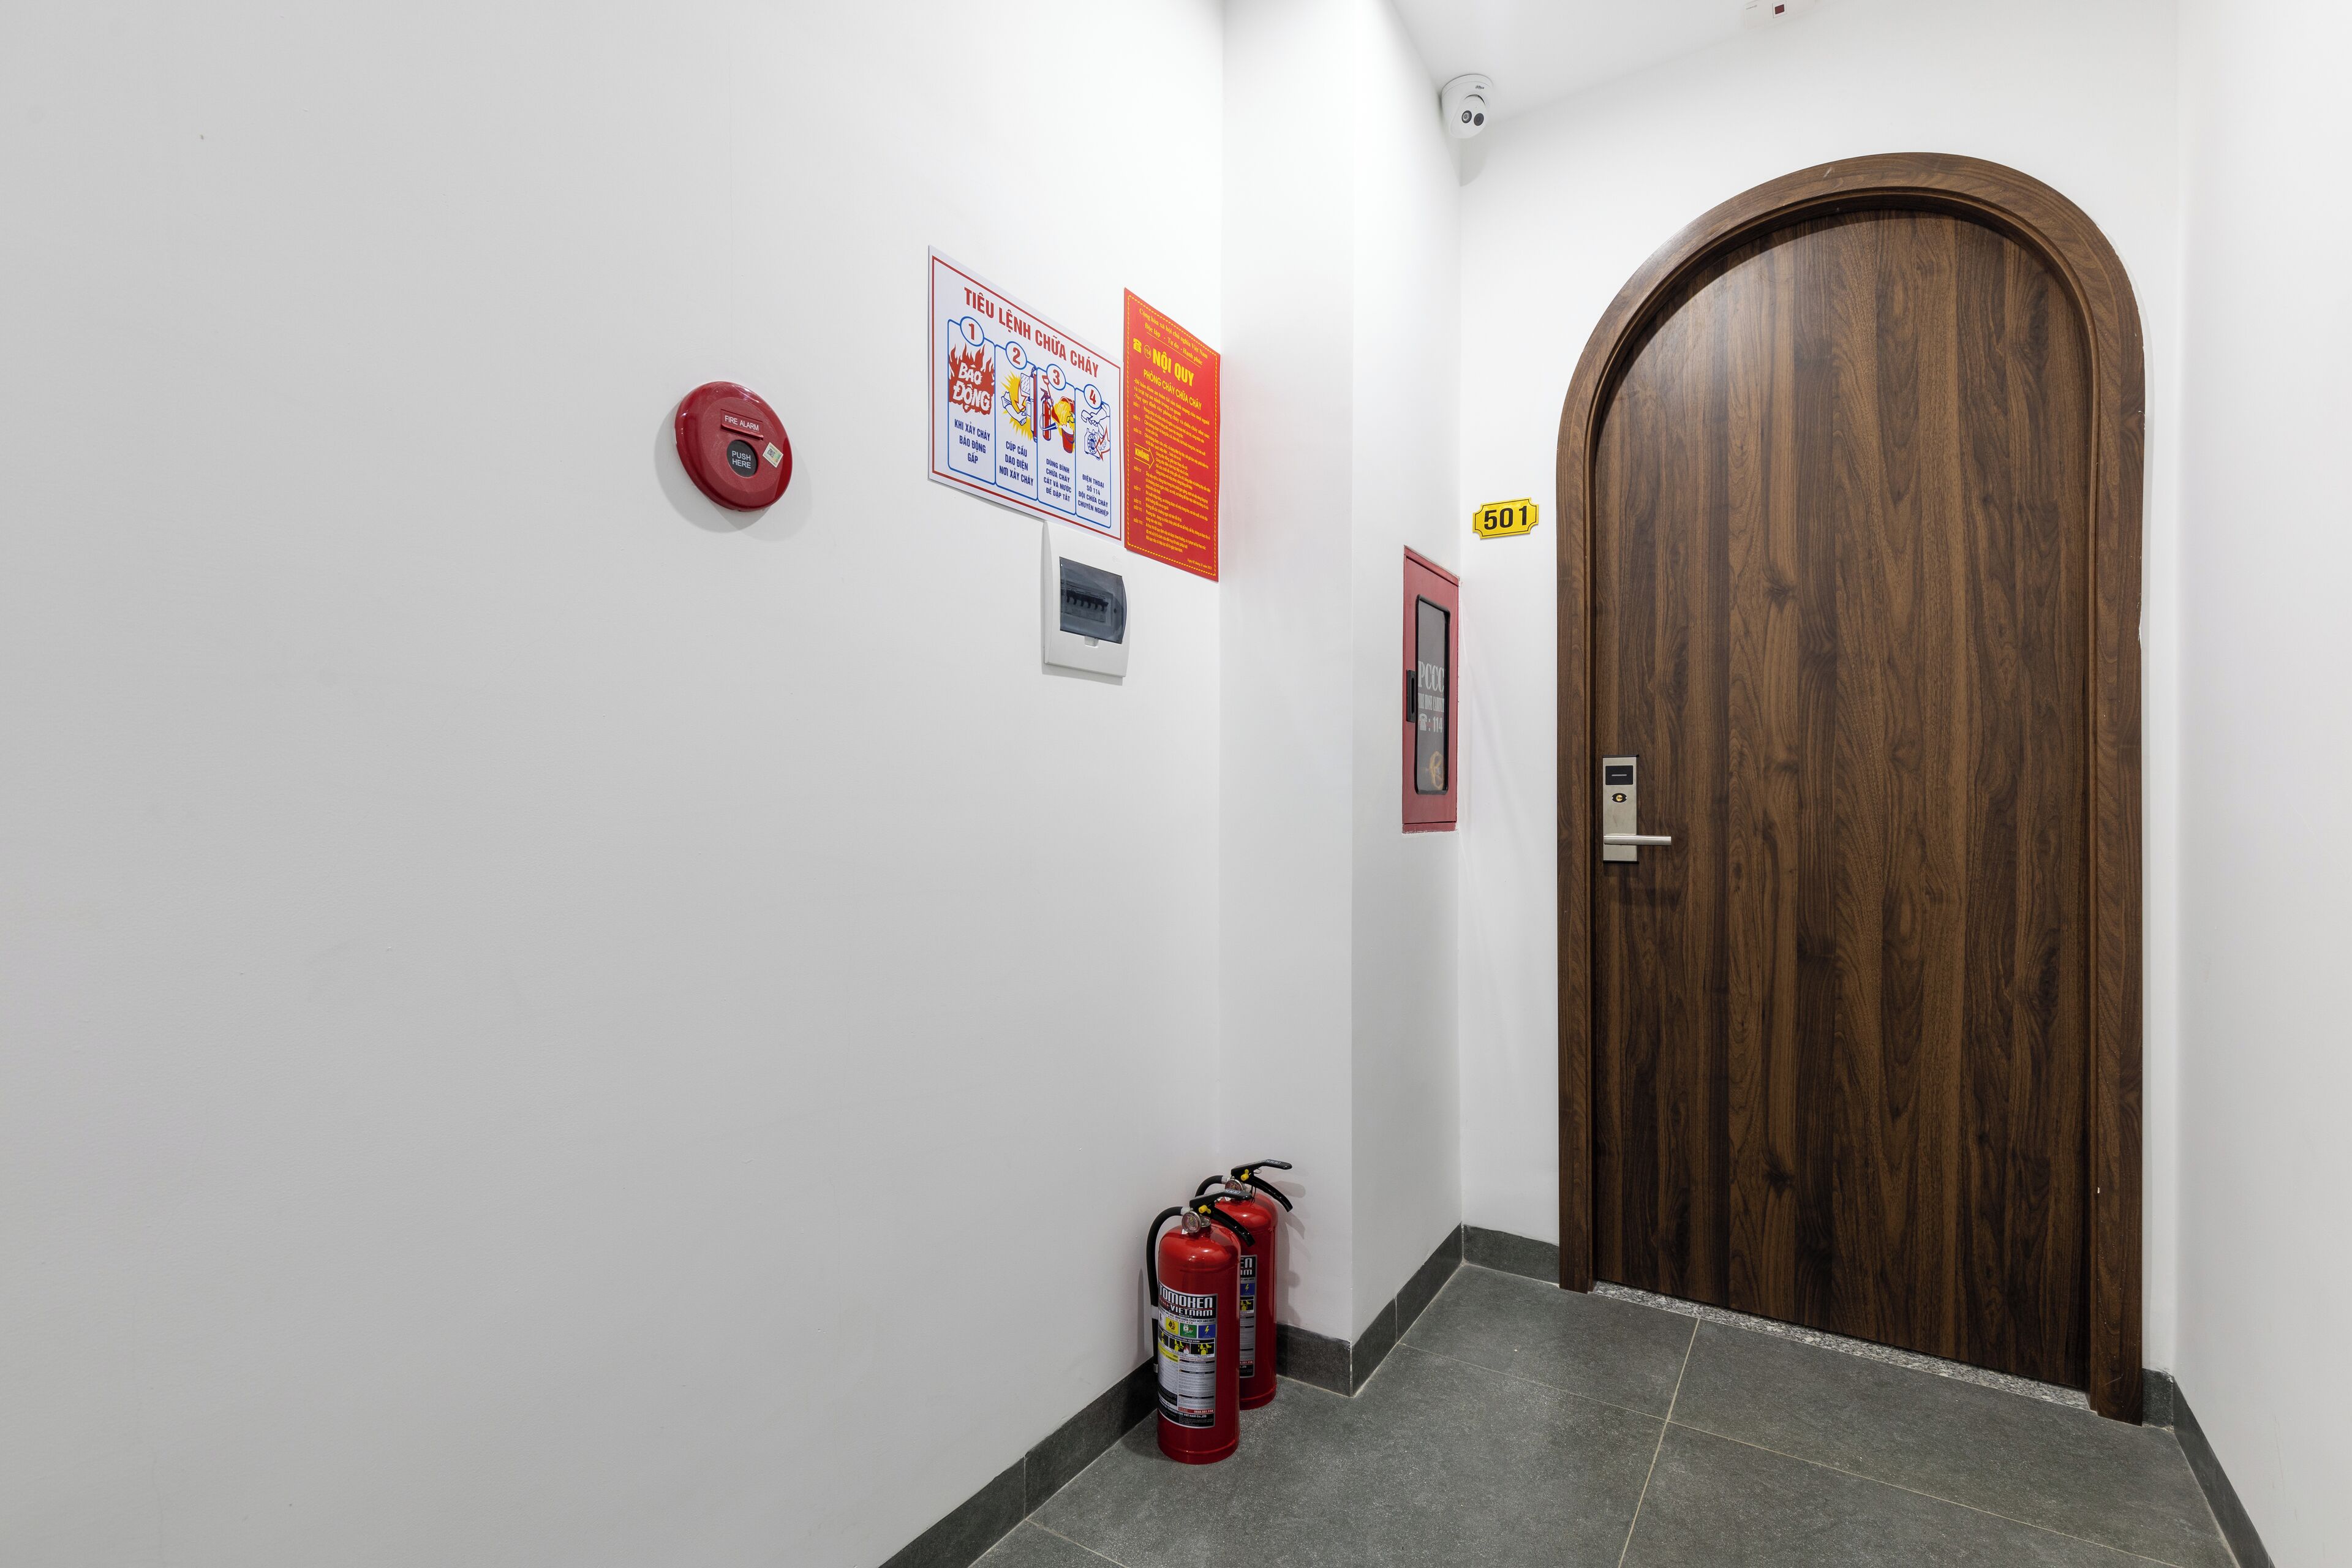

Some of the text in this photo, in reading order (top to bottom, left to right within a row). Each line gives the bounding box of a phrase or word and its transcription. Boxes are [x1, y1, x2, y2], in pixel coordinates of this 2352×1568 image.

[964, 287, 1099, 378] TIÊU LỆNH CHỮA CHÁY
[968, 323, 974, 341] 1
[1012, 347, 1020, 365] 2
[1153, 348, 1194, 386] NỘI QUY
[1053, 369, 1060, 385] 3
[1090, 390, 1096, 405] 4
[1144, 369, 1202, 410] PHÒNG CHÁY CHỮA CHÁY
[725, 415, 759, 431] FIRE ALARM
[954, 418, 990, 442] KHI XẢY CHÁY
[959, 435, 986, 454] BÁO ĐỘNG
[1006, 440, 1016, 452] CÚP
[732, 451, 751, 461] PUSH
[967, 451, 978, 464] GẤP
[1005, 454, 1028, 471] DAO ĐIỆN
[1135, 448, 1149, 461] KHÔNG
[732, 459, 752, 469] HERE
[999, 465, 1033, 486] NƠI XẢY CHÁY
[1059, 473, 1070, 483] CHÁY
[1098, 499, 1108, 508] CHÁY
[1484, 505, 1527, 530] 501
[1418, 661, 1444, 693] PCCC
[1433, 716, 1442, 733] 114
[1159, 1284, 1213, 1308] TOMOKEN
